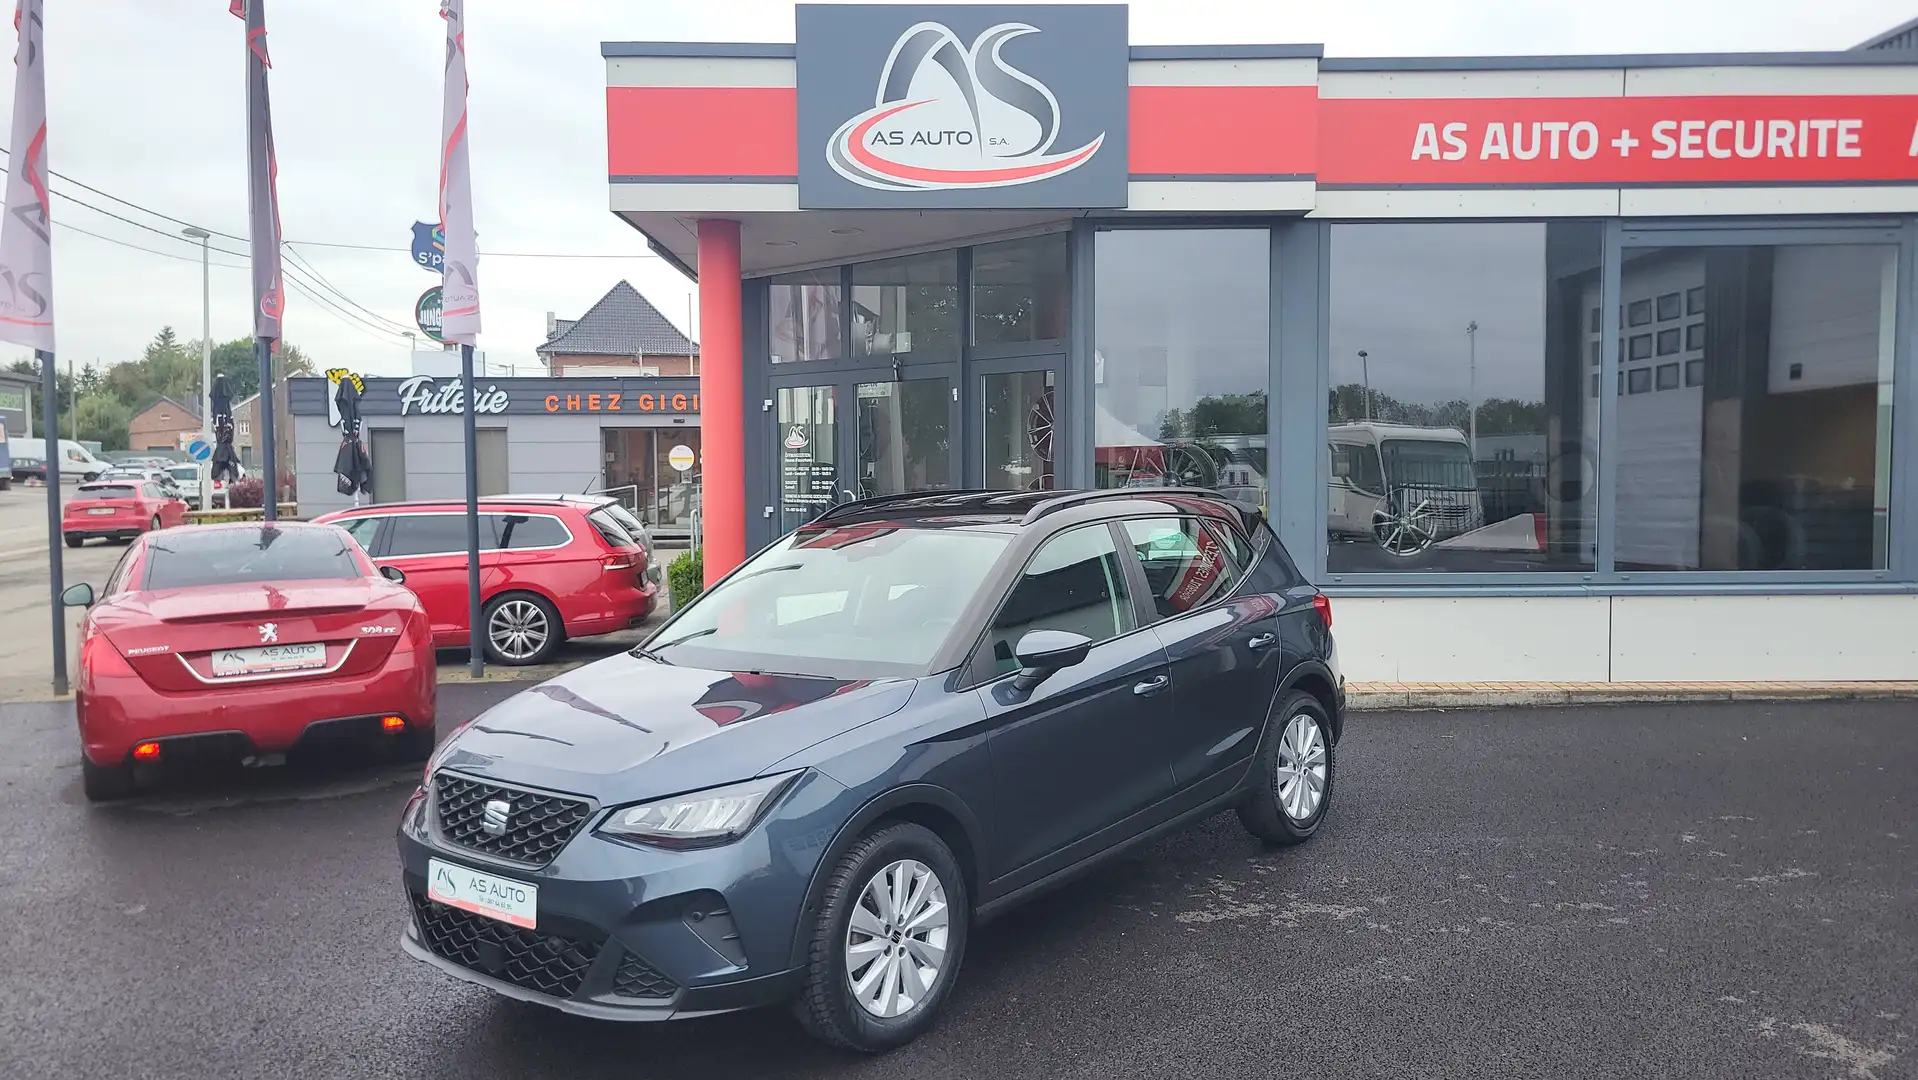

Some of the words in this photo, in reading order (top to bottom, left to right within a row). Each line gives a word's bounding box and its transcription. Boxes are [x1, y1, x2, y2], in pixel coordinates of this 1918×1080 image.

[871, 130, 904, 146] AS
[910, 130, 973, 146] AUTO
[988, 137, 1010, 146] S.A.
[1411, 122, 1468, 161] AS
[1480, 121, 1599, 161] AUTO
[1611, 128, 1639, 157] +
[1651, 119, 1863, 160] SECURITE
[419, 306, 444, 327] JUNG
[544, 394, 622, 412] CHEZ
[639, 393, 698, 411] GIGI
[260, 648, 279, 658] AS
[281, 644, 317, 656] AUTO
[469, 877, 487, 893] AS
[490, 883, 526, 903] AUTO
